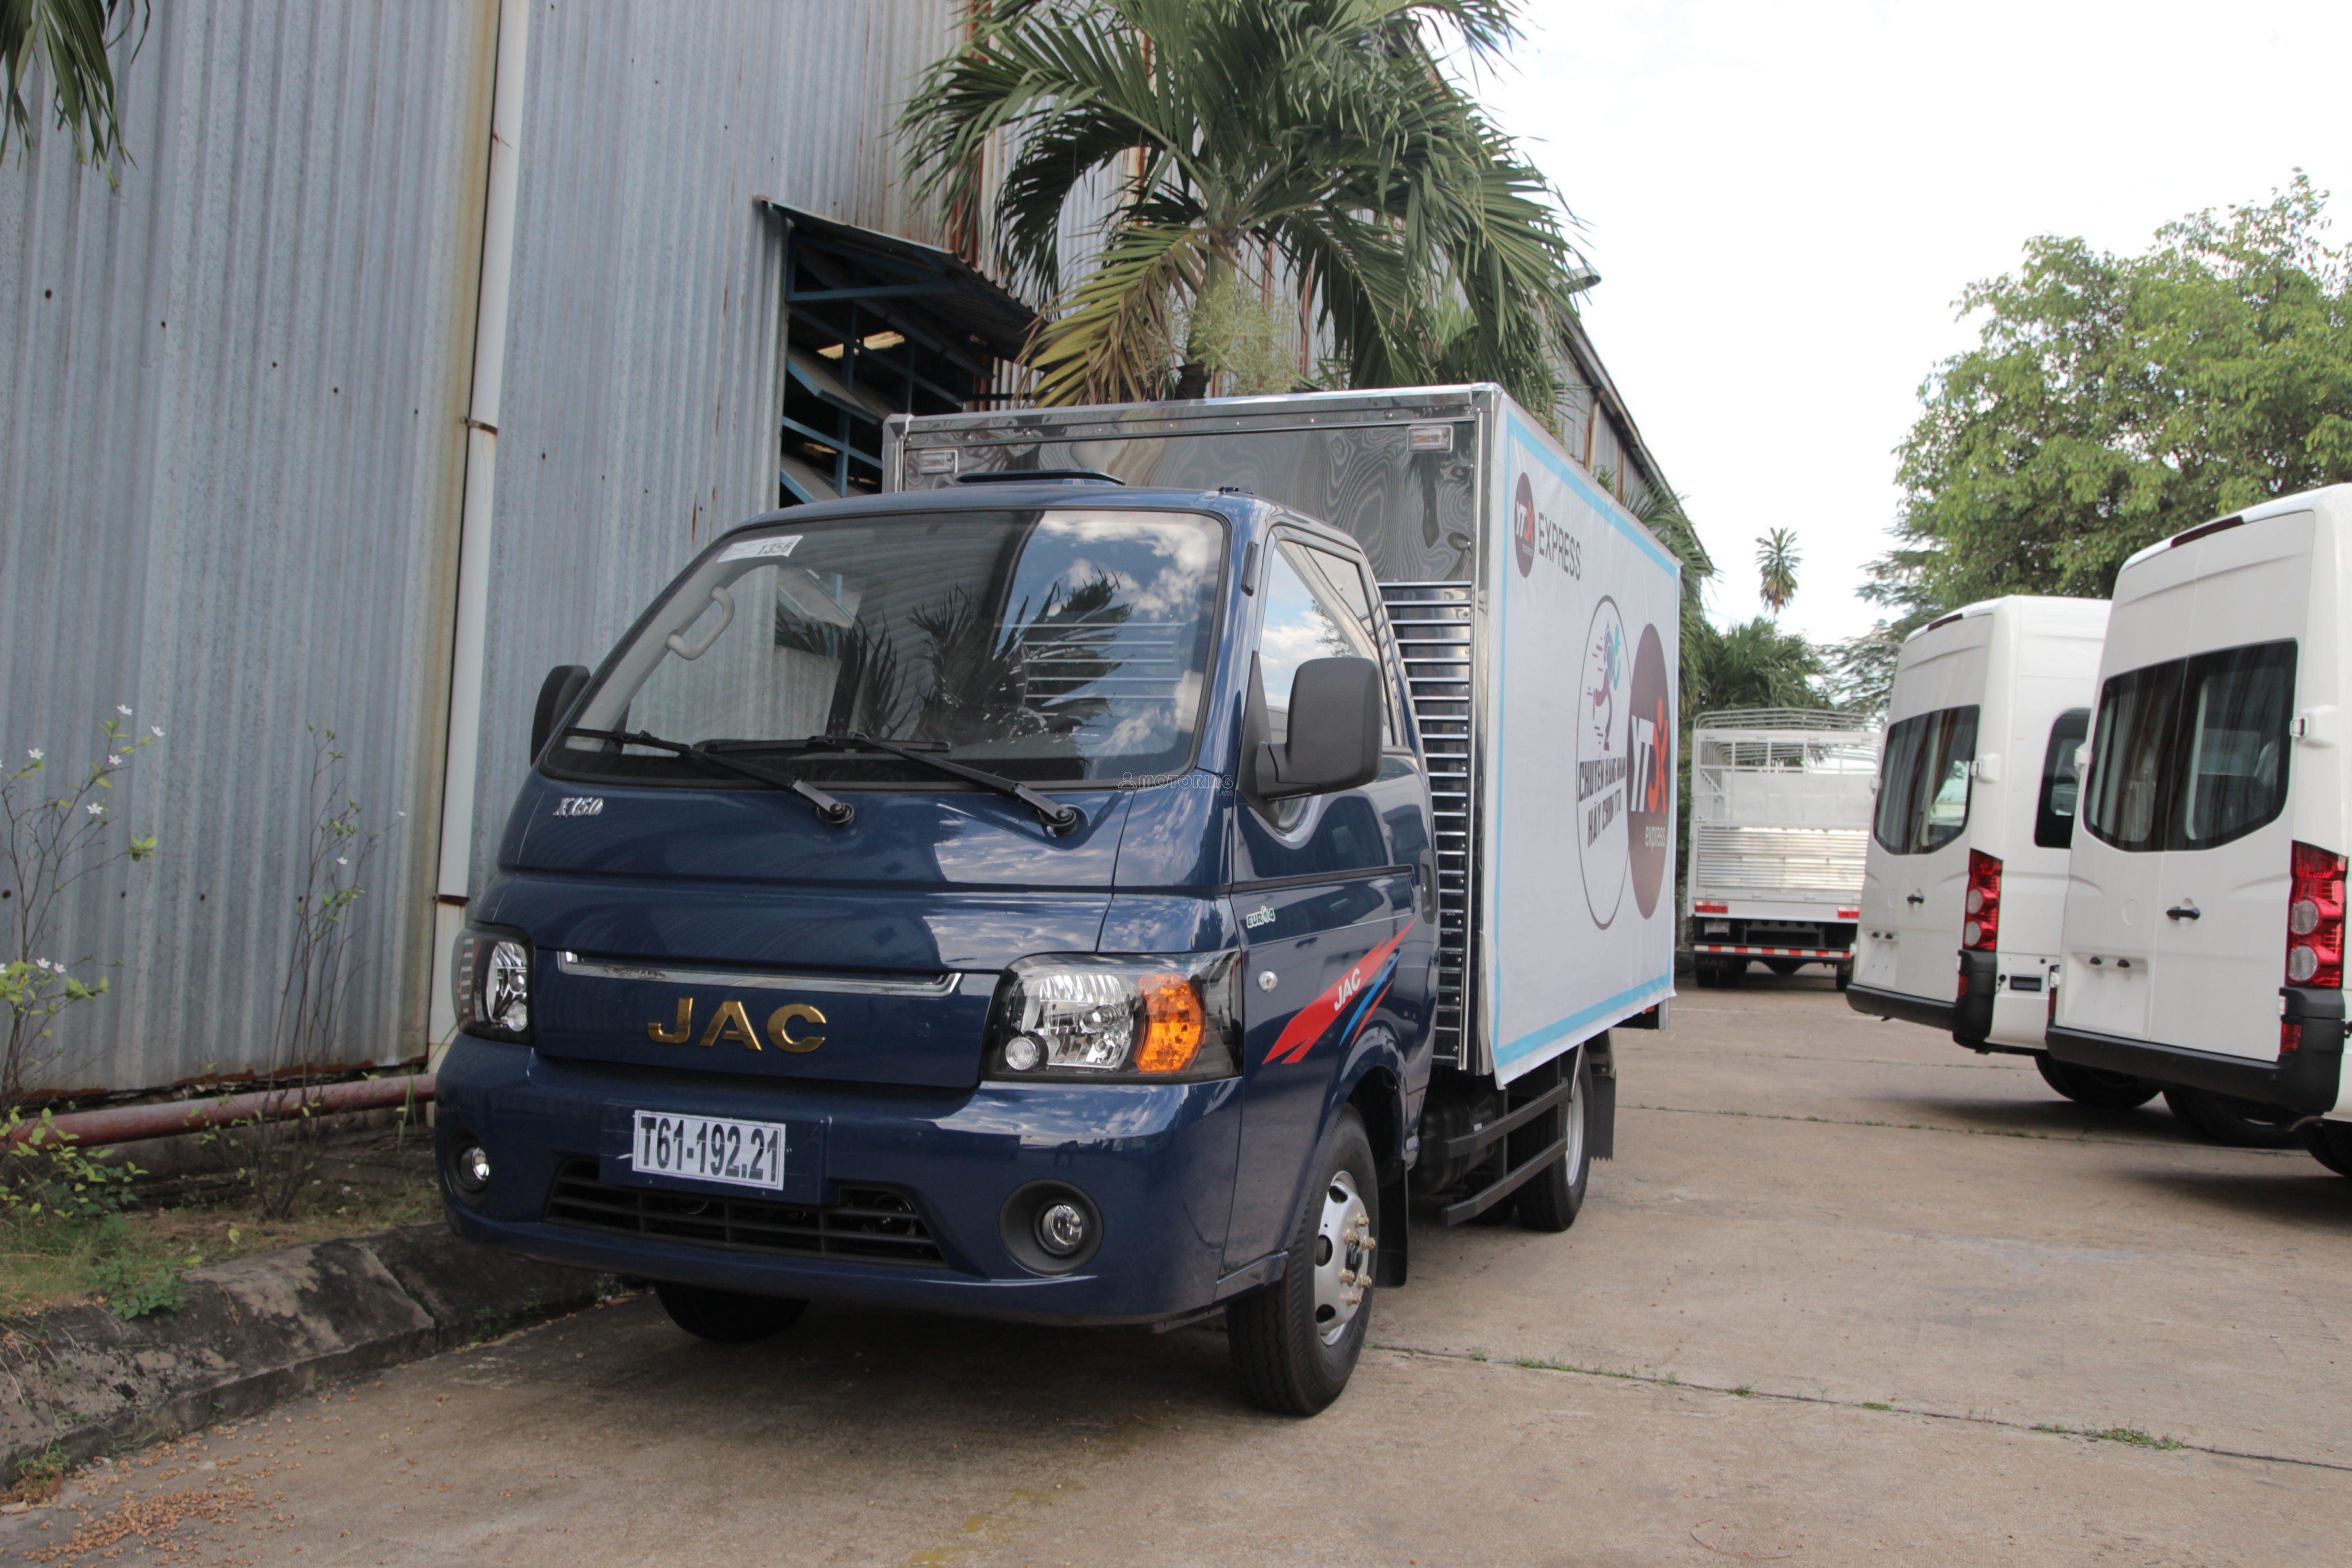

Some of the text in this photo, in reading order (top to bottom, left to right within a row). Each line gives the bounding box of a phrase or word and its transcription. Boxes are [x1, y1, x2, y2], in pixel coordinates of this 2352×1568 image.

[1539, 511, 1581, 581] EXPRESS
[1646, 826, 1666, 853] express
[1334, 968, 1361, 1011] JAC
[648, 998, 827, 1053] JAC
[640, 1117, 779, 1182] T61-192.21
